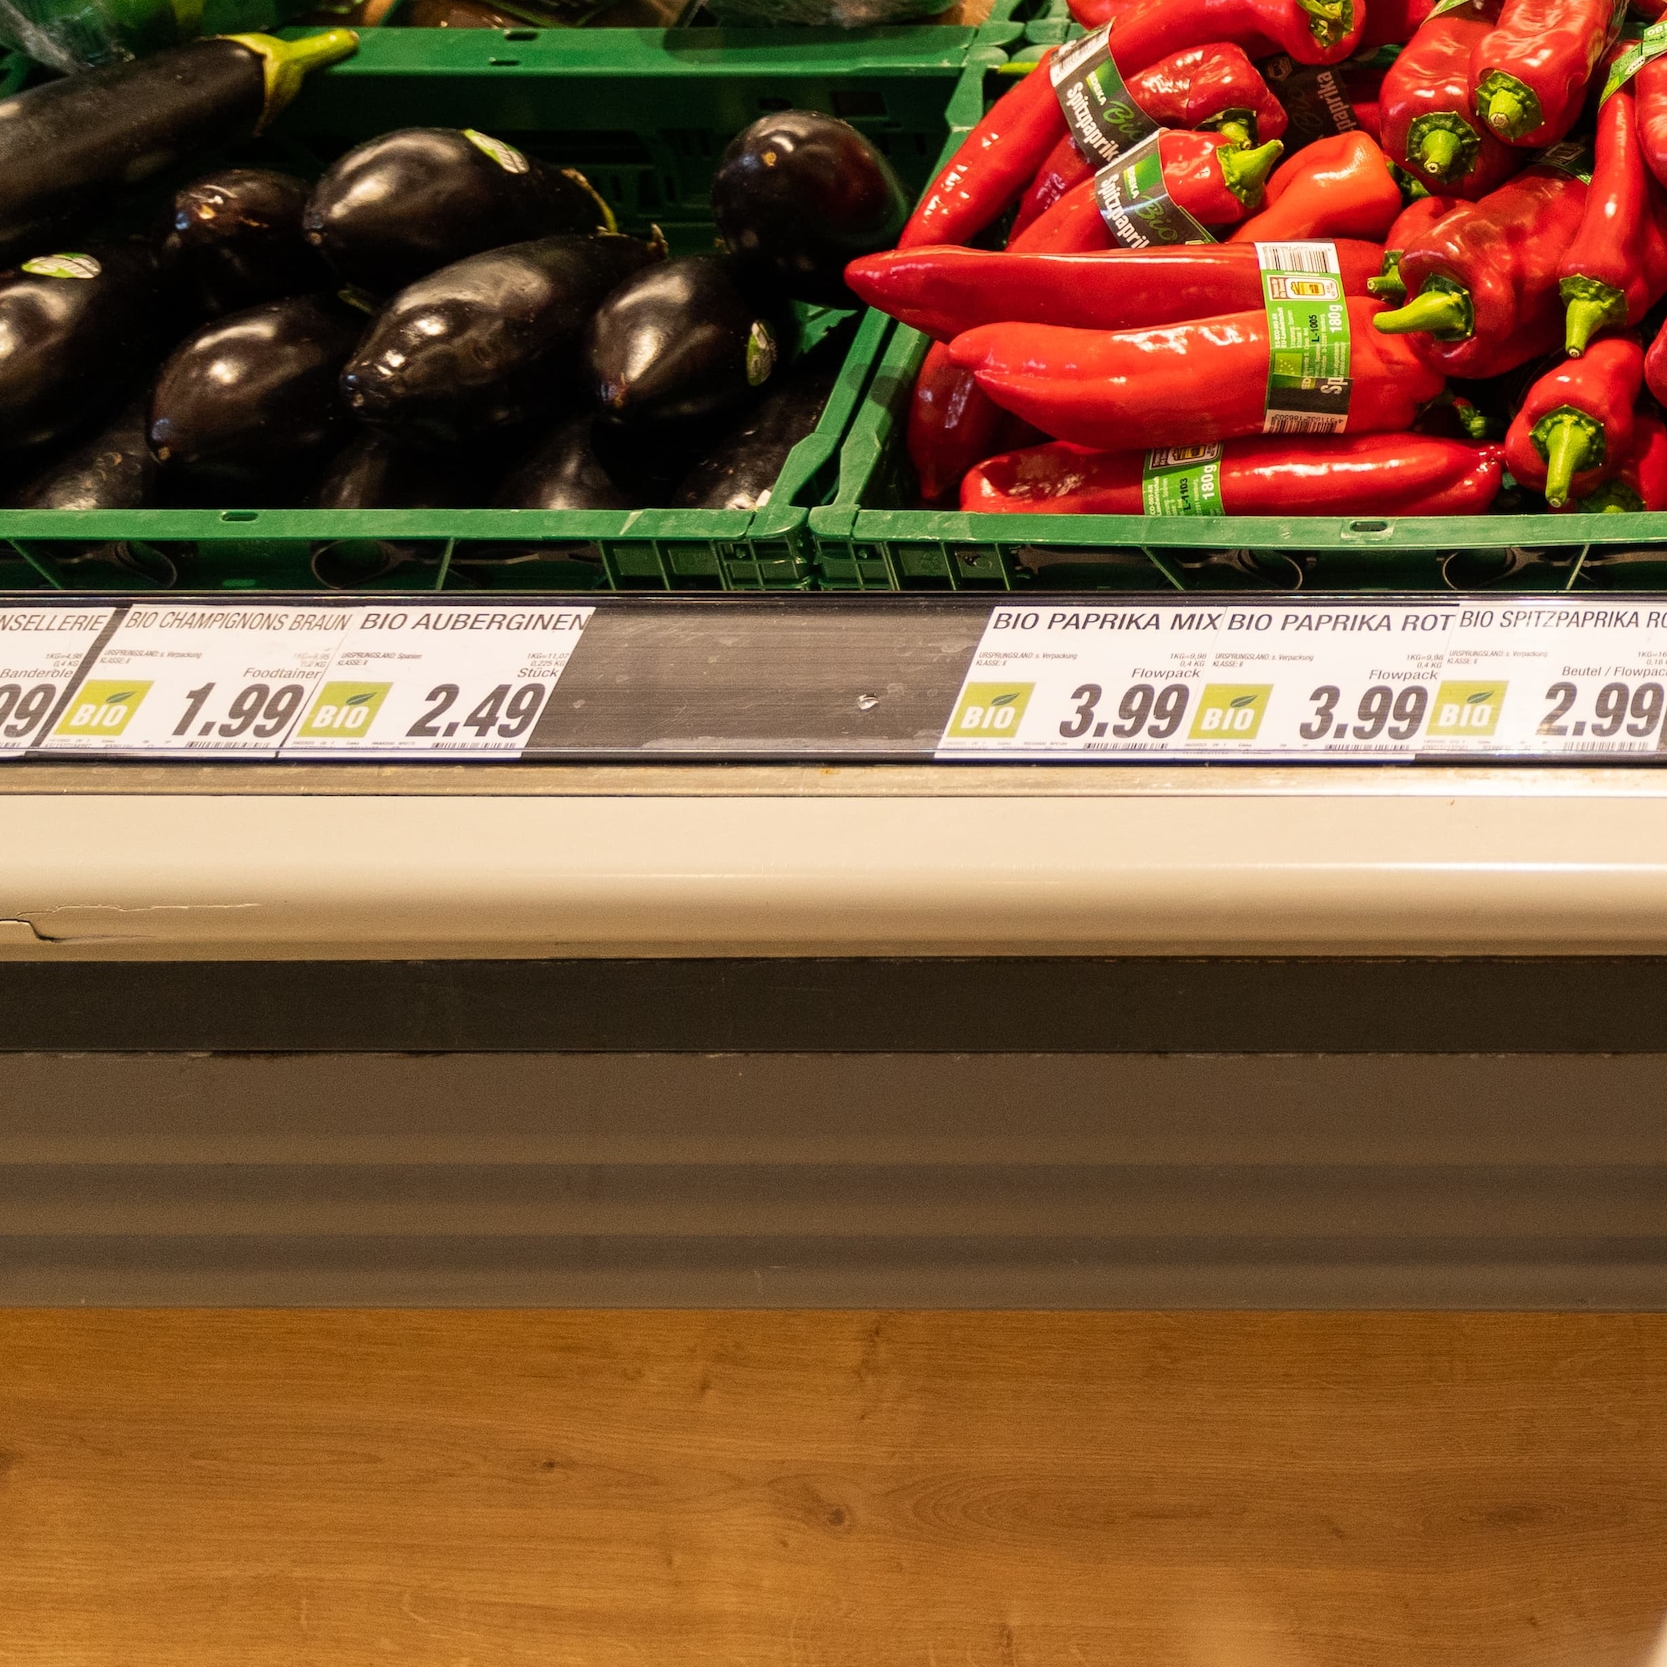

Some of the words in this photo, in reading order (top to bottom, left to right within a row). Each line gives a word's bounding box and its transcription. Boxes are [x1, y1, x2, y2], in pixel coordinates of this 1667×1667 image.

[1135, 195, 1178, 242] Bio
[1328, 304, 1343, 333] 180g
[1201, 464, 1217, 500] 180g
[1180, 478, 1191, 511] L-1103
[126, 612, 158, 628] BIO
[160, 612, 290, 630] CHAMPIGNONS
[290, 614, 352, 630] BRAUN
[360, 613, 409, 630] BIO
[411, 614, 591, 631] AUBERGINEN
[993, 613, 1039, 630] BIO
[1048, 613, 1160, 630] PAPRIKA
[1170, 614, 1223, 630] MIX
[1228, 613, 1272, 630] BIO
[1281, 614, 1392, 631] PAPRIKA
[1401, 614, 1456, 631] ROT
[1459, 611, 1493, 627] BIO
[1500, 611, 1639, 628] SPITZPAPRIKA
[243, 667, 322, 680] Foodtainer
[518, 668, 559, 678] Stück
[1132, 668, 1201, 679] Flowpack
[1369, 670, 1438, 681] Flowpack
[1562, 666, 1601, 677] Beutel
[71, 704, 128, 726] BIO
[172, 683, 304, 738] 1.99
[312, 705, 369, 728] BIO
[406, 684, 546, 738] 2.49
[961, 706, 1014, 729] BIO
[1059, 684, 1189, 738] 3.99
[1201, 707, 1254, 730] BIO
[1299, 685, 1428, 740] 3.99
[1439, 704, 1492, 726] BIO
[1536, 682, 1664, 737] 2.99
